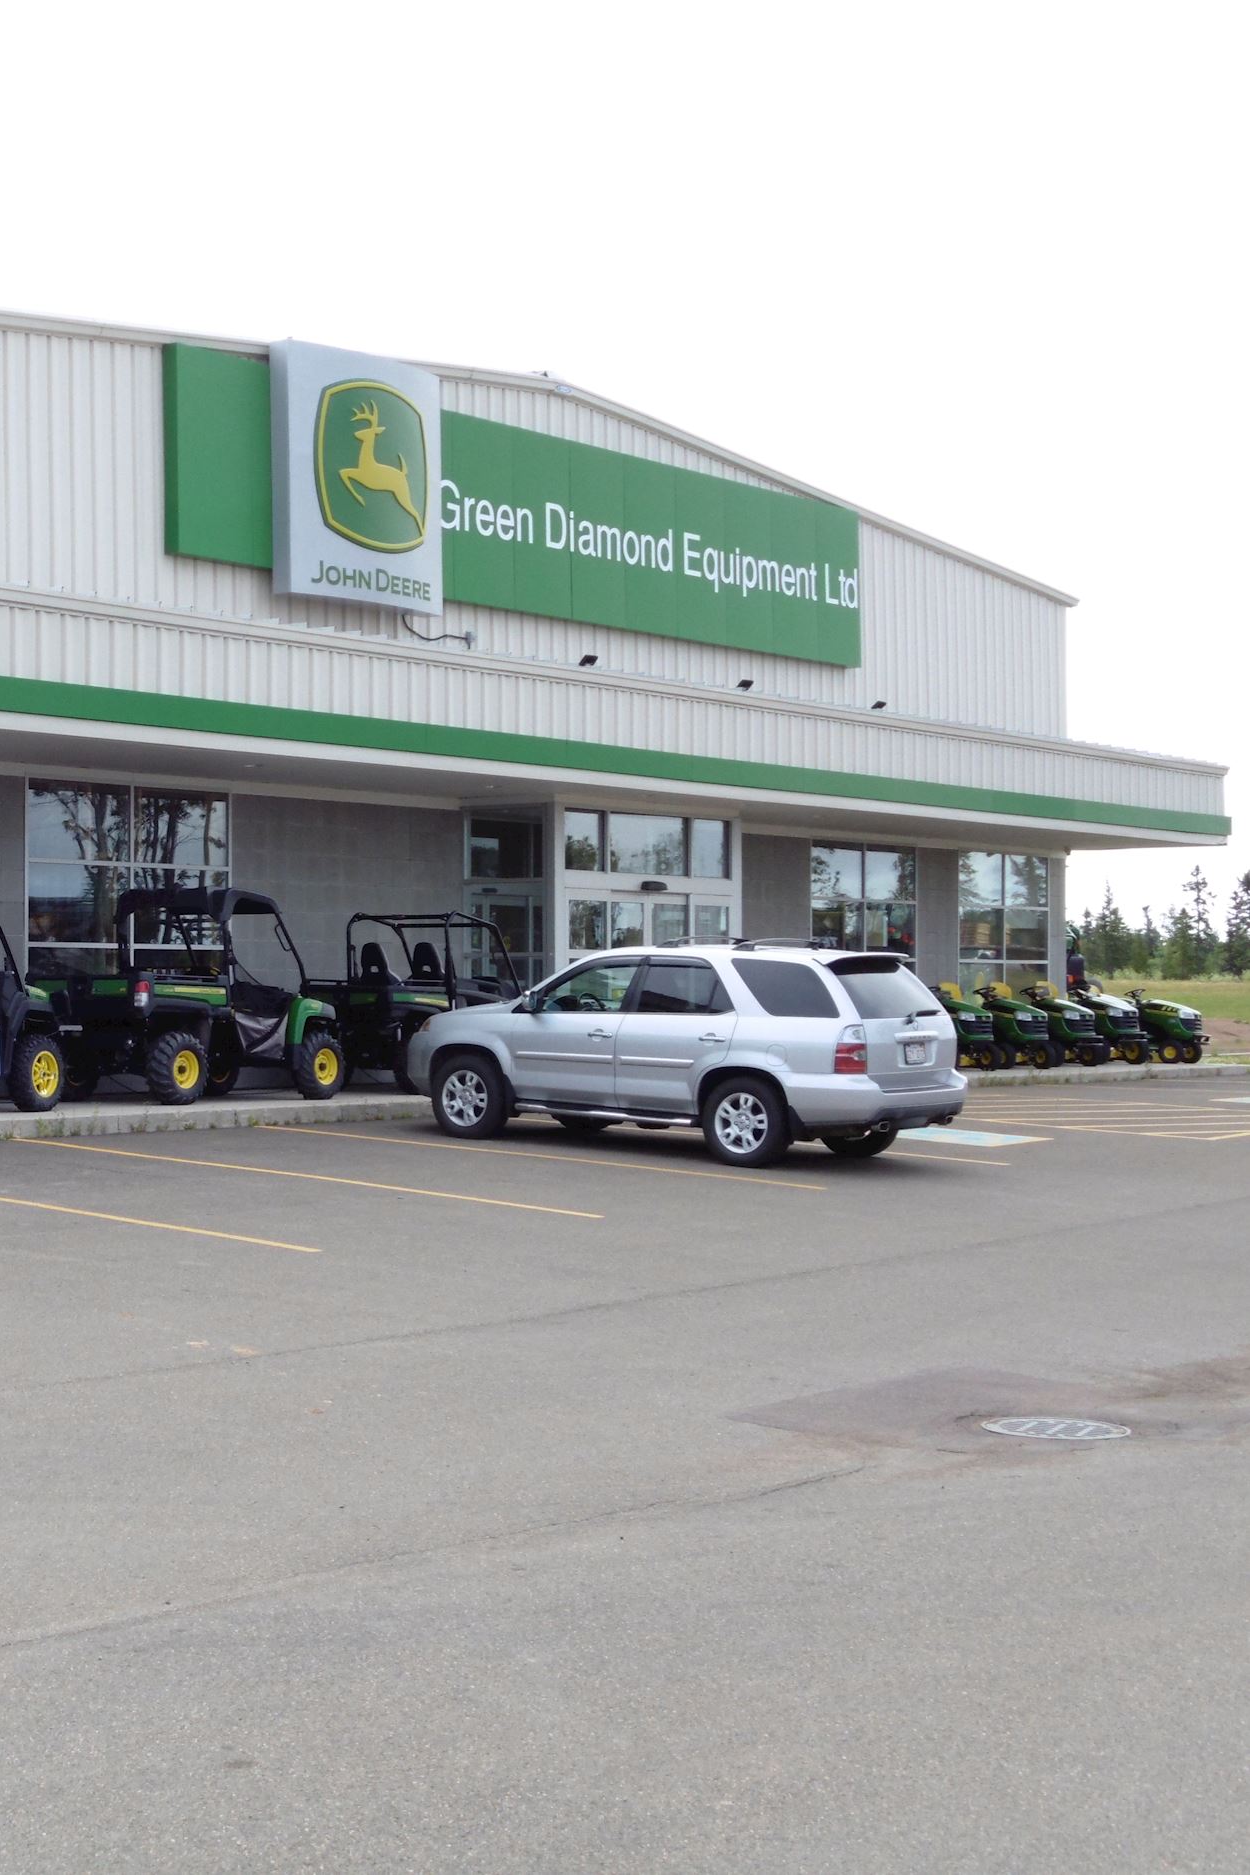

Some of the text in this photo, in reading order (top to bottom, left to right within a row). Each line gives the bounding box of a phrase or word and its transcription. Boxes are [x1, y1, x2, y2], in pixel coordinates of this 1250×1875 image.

[311, 560, 430, 601] JOHN DEERE
[440, 479, 858, 609] Green Diamond Equipment Ltd
